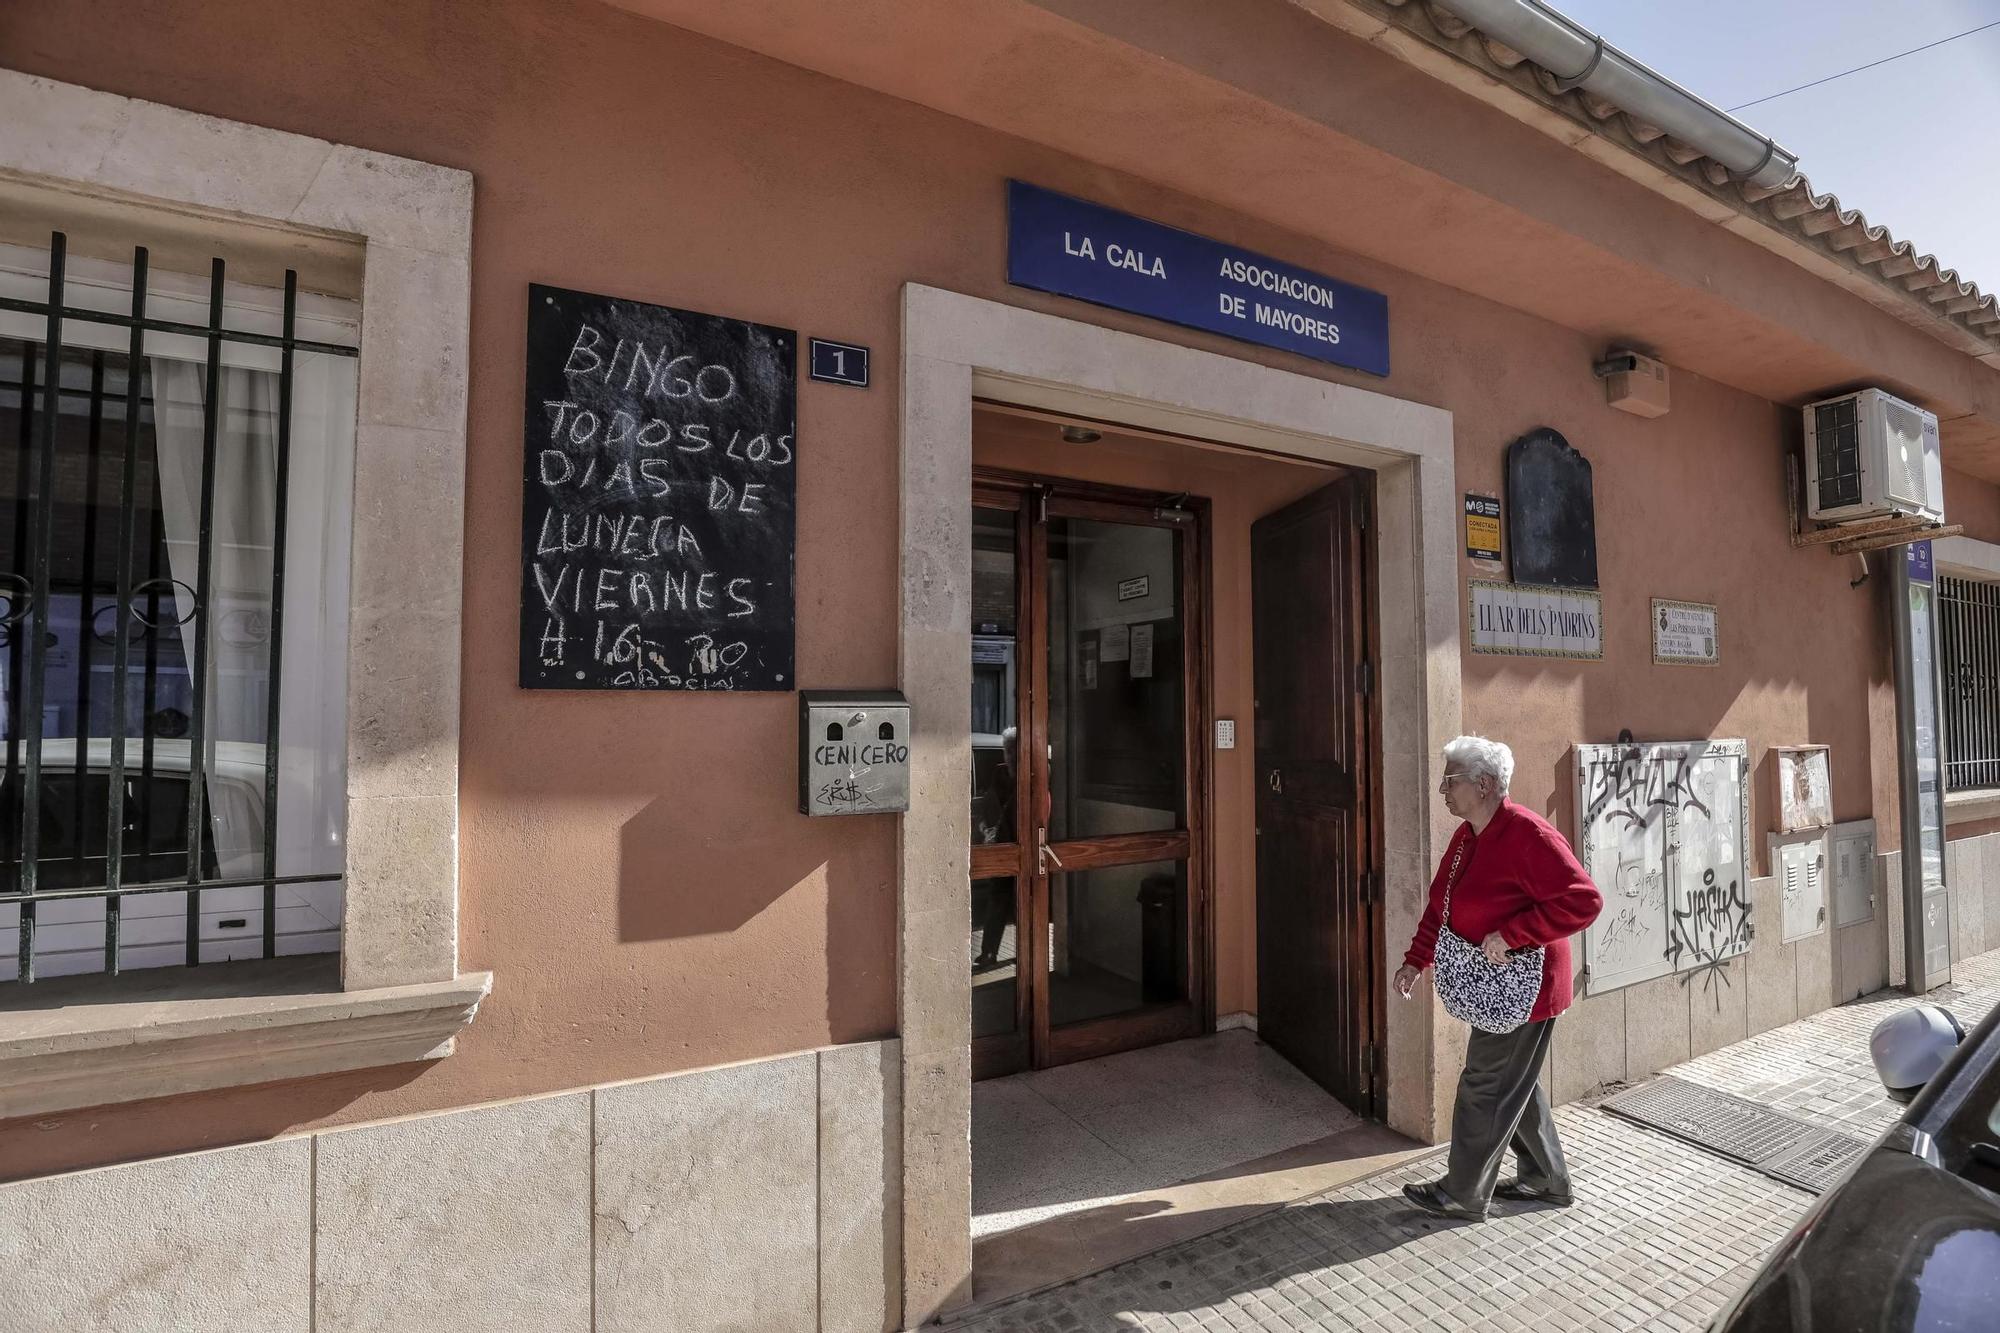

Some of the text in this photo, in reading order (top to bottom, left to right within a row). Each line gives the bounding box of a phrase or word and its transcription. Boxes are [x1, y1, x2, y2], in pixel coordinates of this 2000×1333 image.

[1064, 231, 1167, 280] LA CALA
[1219, 257, 1334, 309] ASOCIACION
[1219, 293, 1340, 345] DE MAYORES
[564, 323, 737, 402] BINGO
[832, 350, 848, 376] 1
[543, 400, 793, 465] TODOS LOS
[539, 449, 766, 513] DIAS DE
[532, 563, 756, 618] VIERNES
[1479, 604, 1596, 639] LLAR DELS PADRINS
[814, 742, 909, 766] CENICERO
